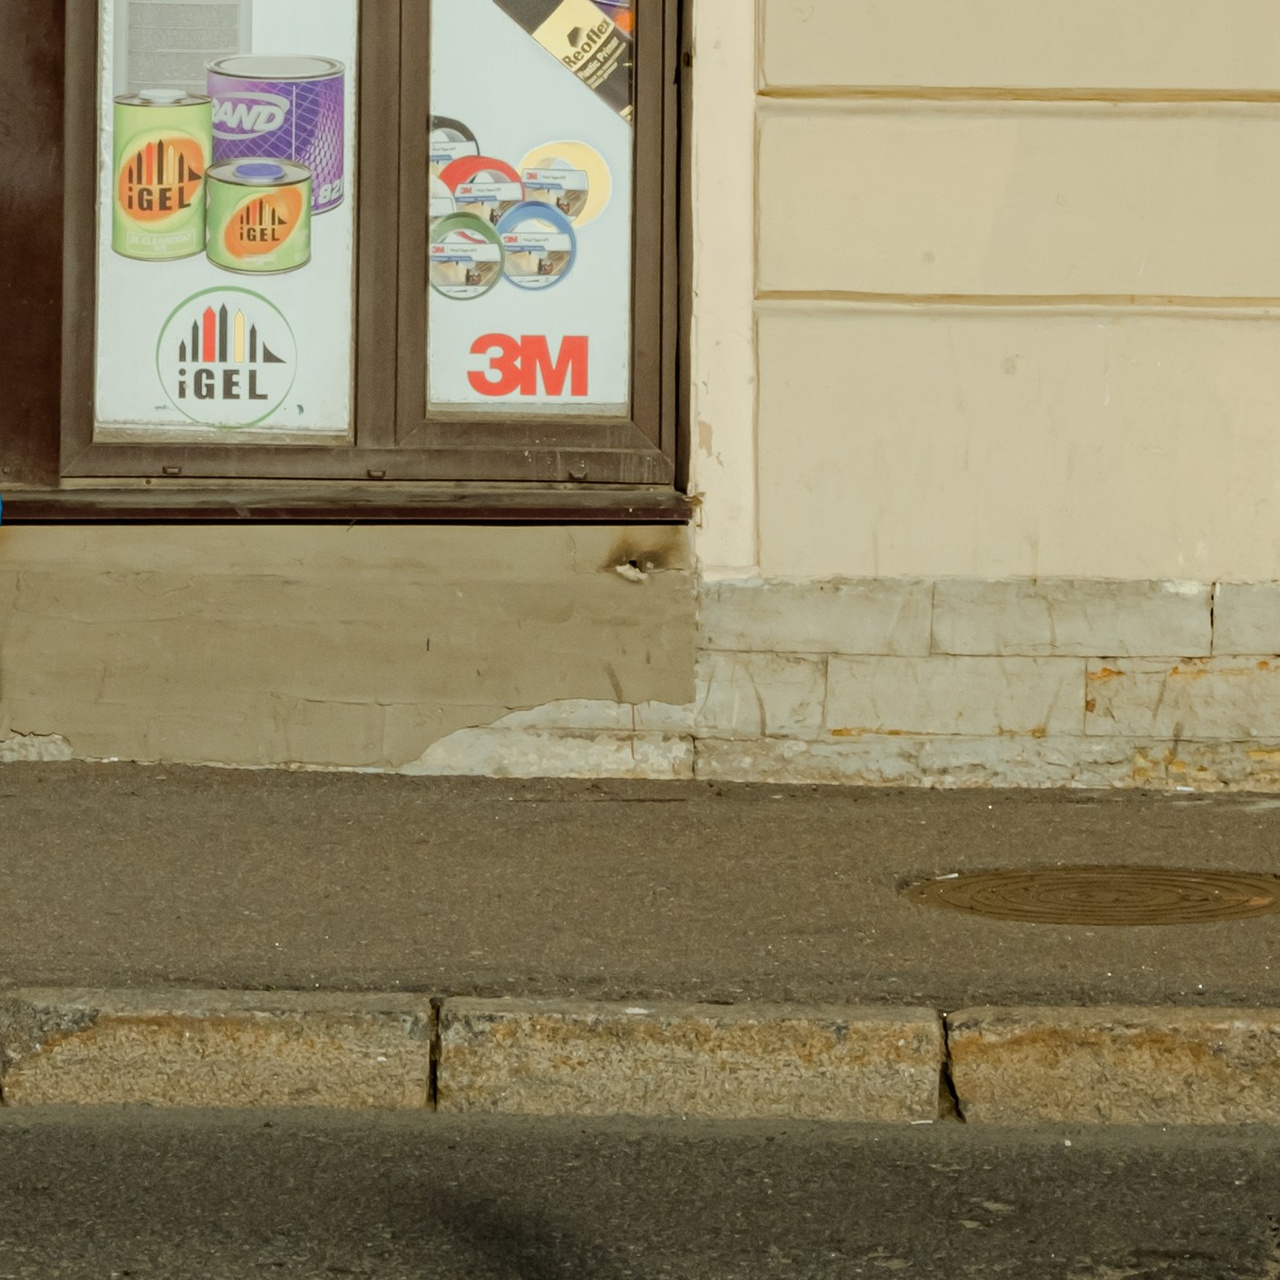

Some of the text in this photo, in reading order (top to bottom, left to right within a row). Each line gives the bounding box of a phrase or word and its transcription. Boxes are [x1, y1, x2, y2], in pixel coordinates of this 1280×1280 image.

[561, 17, 612, 69] Reoflex
[127, 186, 192, 212] iGEL
[239, 226, 281, 243] iGEL
[466, 332, 589, 397] 3M
[178, 367, 269, 401] iGEL
